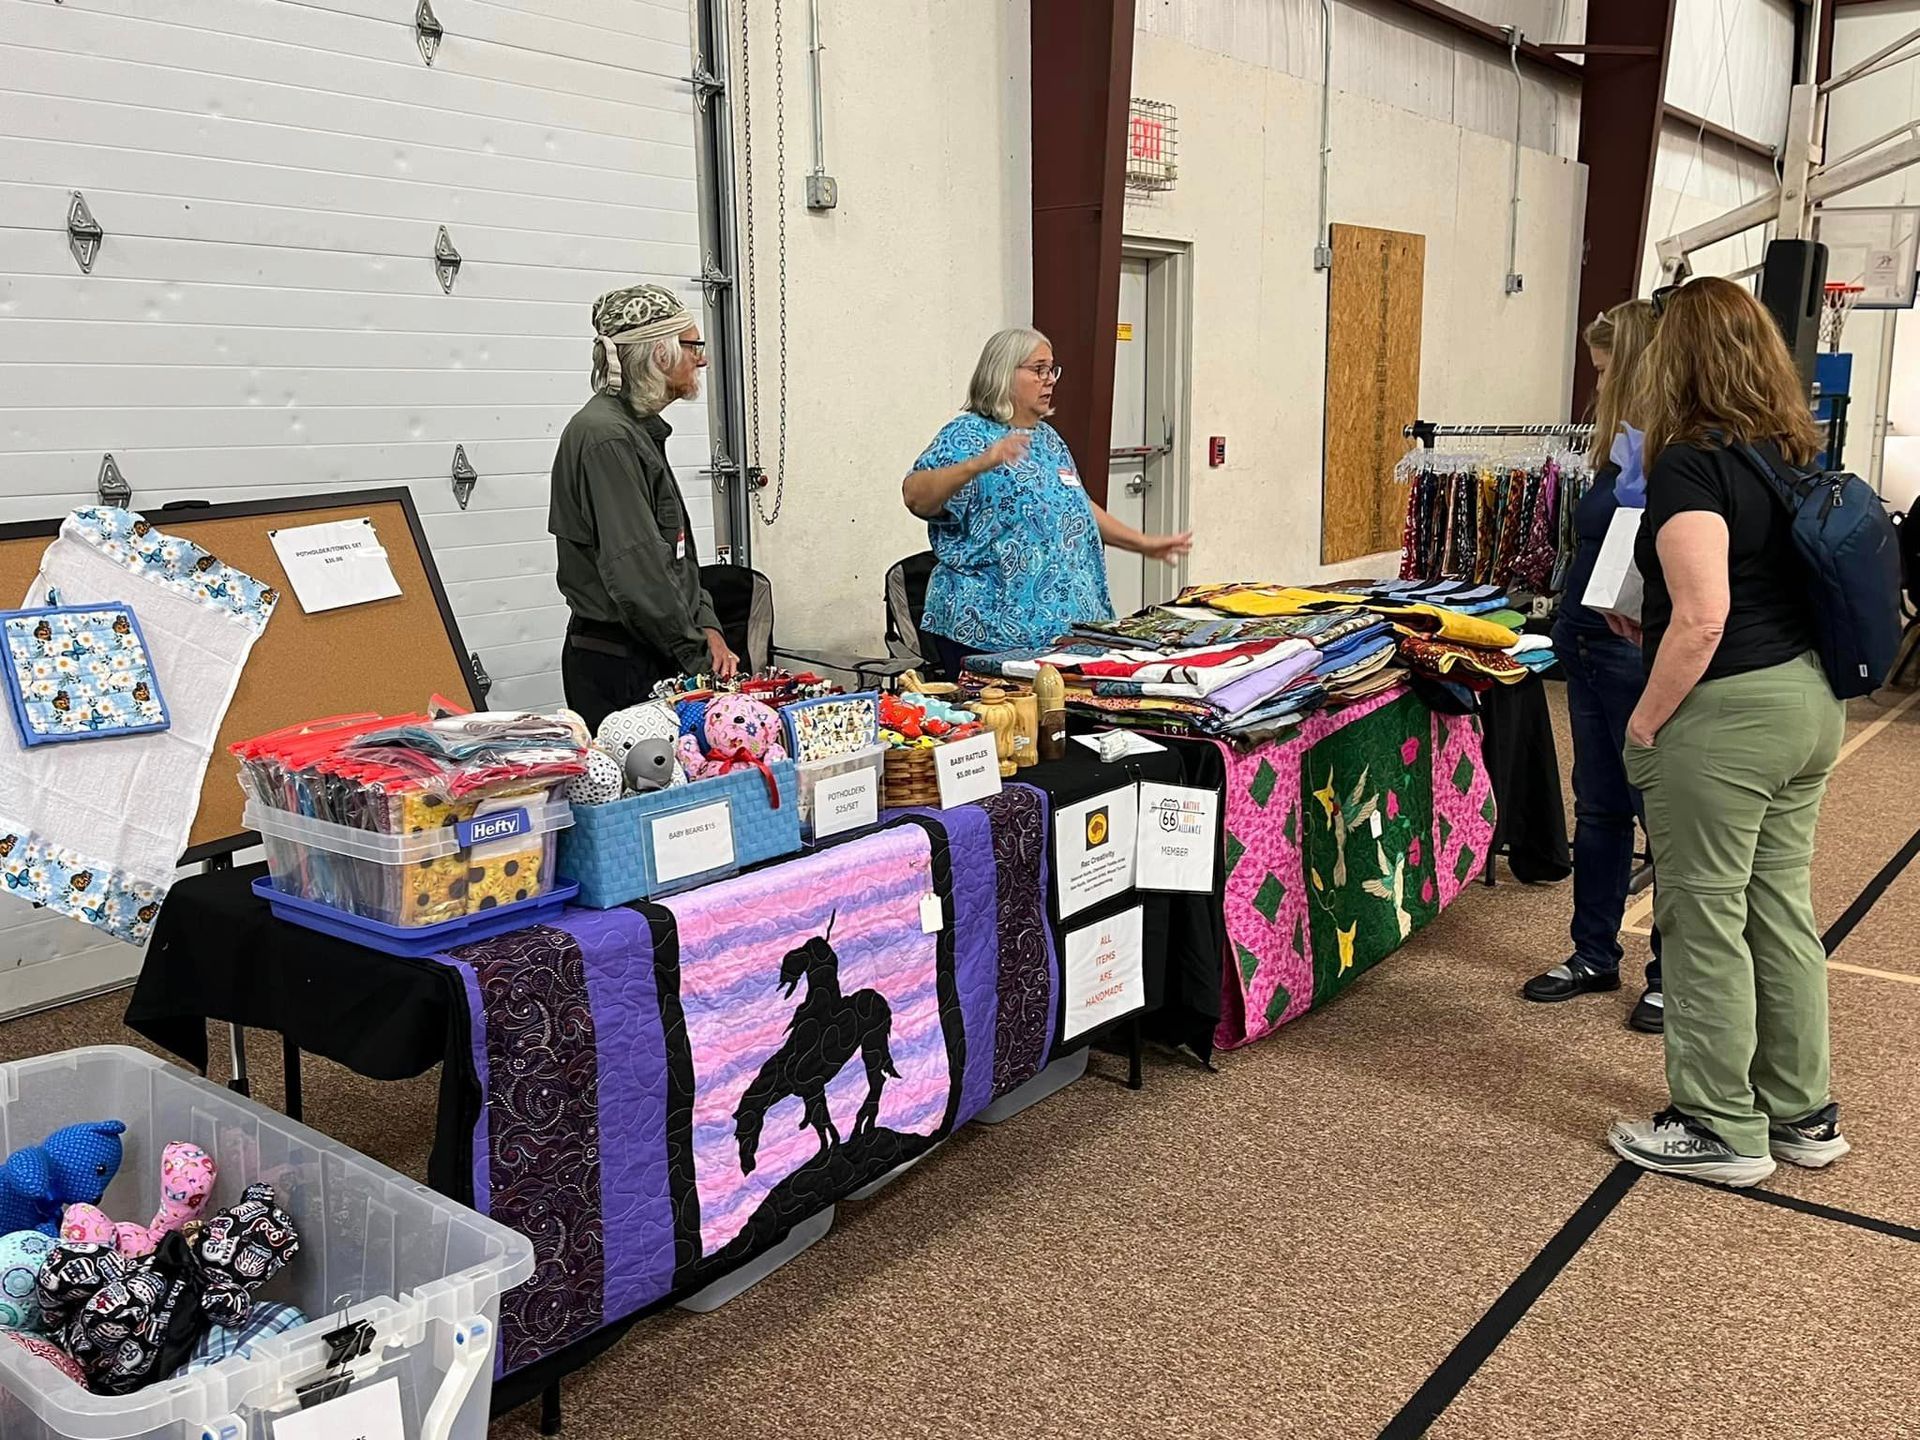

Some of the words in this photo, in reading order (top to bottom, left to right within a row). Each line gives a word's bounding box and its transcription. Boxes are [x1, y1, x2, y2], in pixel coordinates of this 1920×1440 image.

[1133, 117, 1162, 160] EXIT
[296, 545, 351, 558] POTHOLDER/TOWEL
[950, 757, 964, 767] BABY
[966, 749, 988, 762] RATTLES
[956, 769, 971, 779] $5.00
[972, 765, 985, 775] each
[828, 785, 866, 802] POTHOLDERS
[835, 801, 859, 815] $25/SET
[1182, 800, 1201, 811] NATIVE
[1162, 811, 1176, 826] 66
[474, 819, 516, 838] Hefty
[668, 830, 683, 840] BABY
[685, 824, 704, 836] BEARS
[705, 821, 716, 831] $15
[1178, 824, 1202, 835] ALLIANCE
[1091, 851, 1115, 865] Creativity
[1161, 846, 1189, 857] MEMBER
[1100, 934, 1112, 945] ALL
[1096, 950, 1116, 967] ITEMS
[1100, 969, 1113, 981] ARE
[1085, 982, 1124, 1007] HANDMADE
